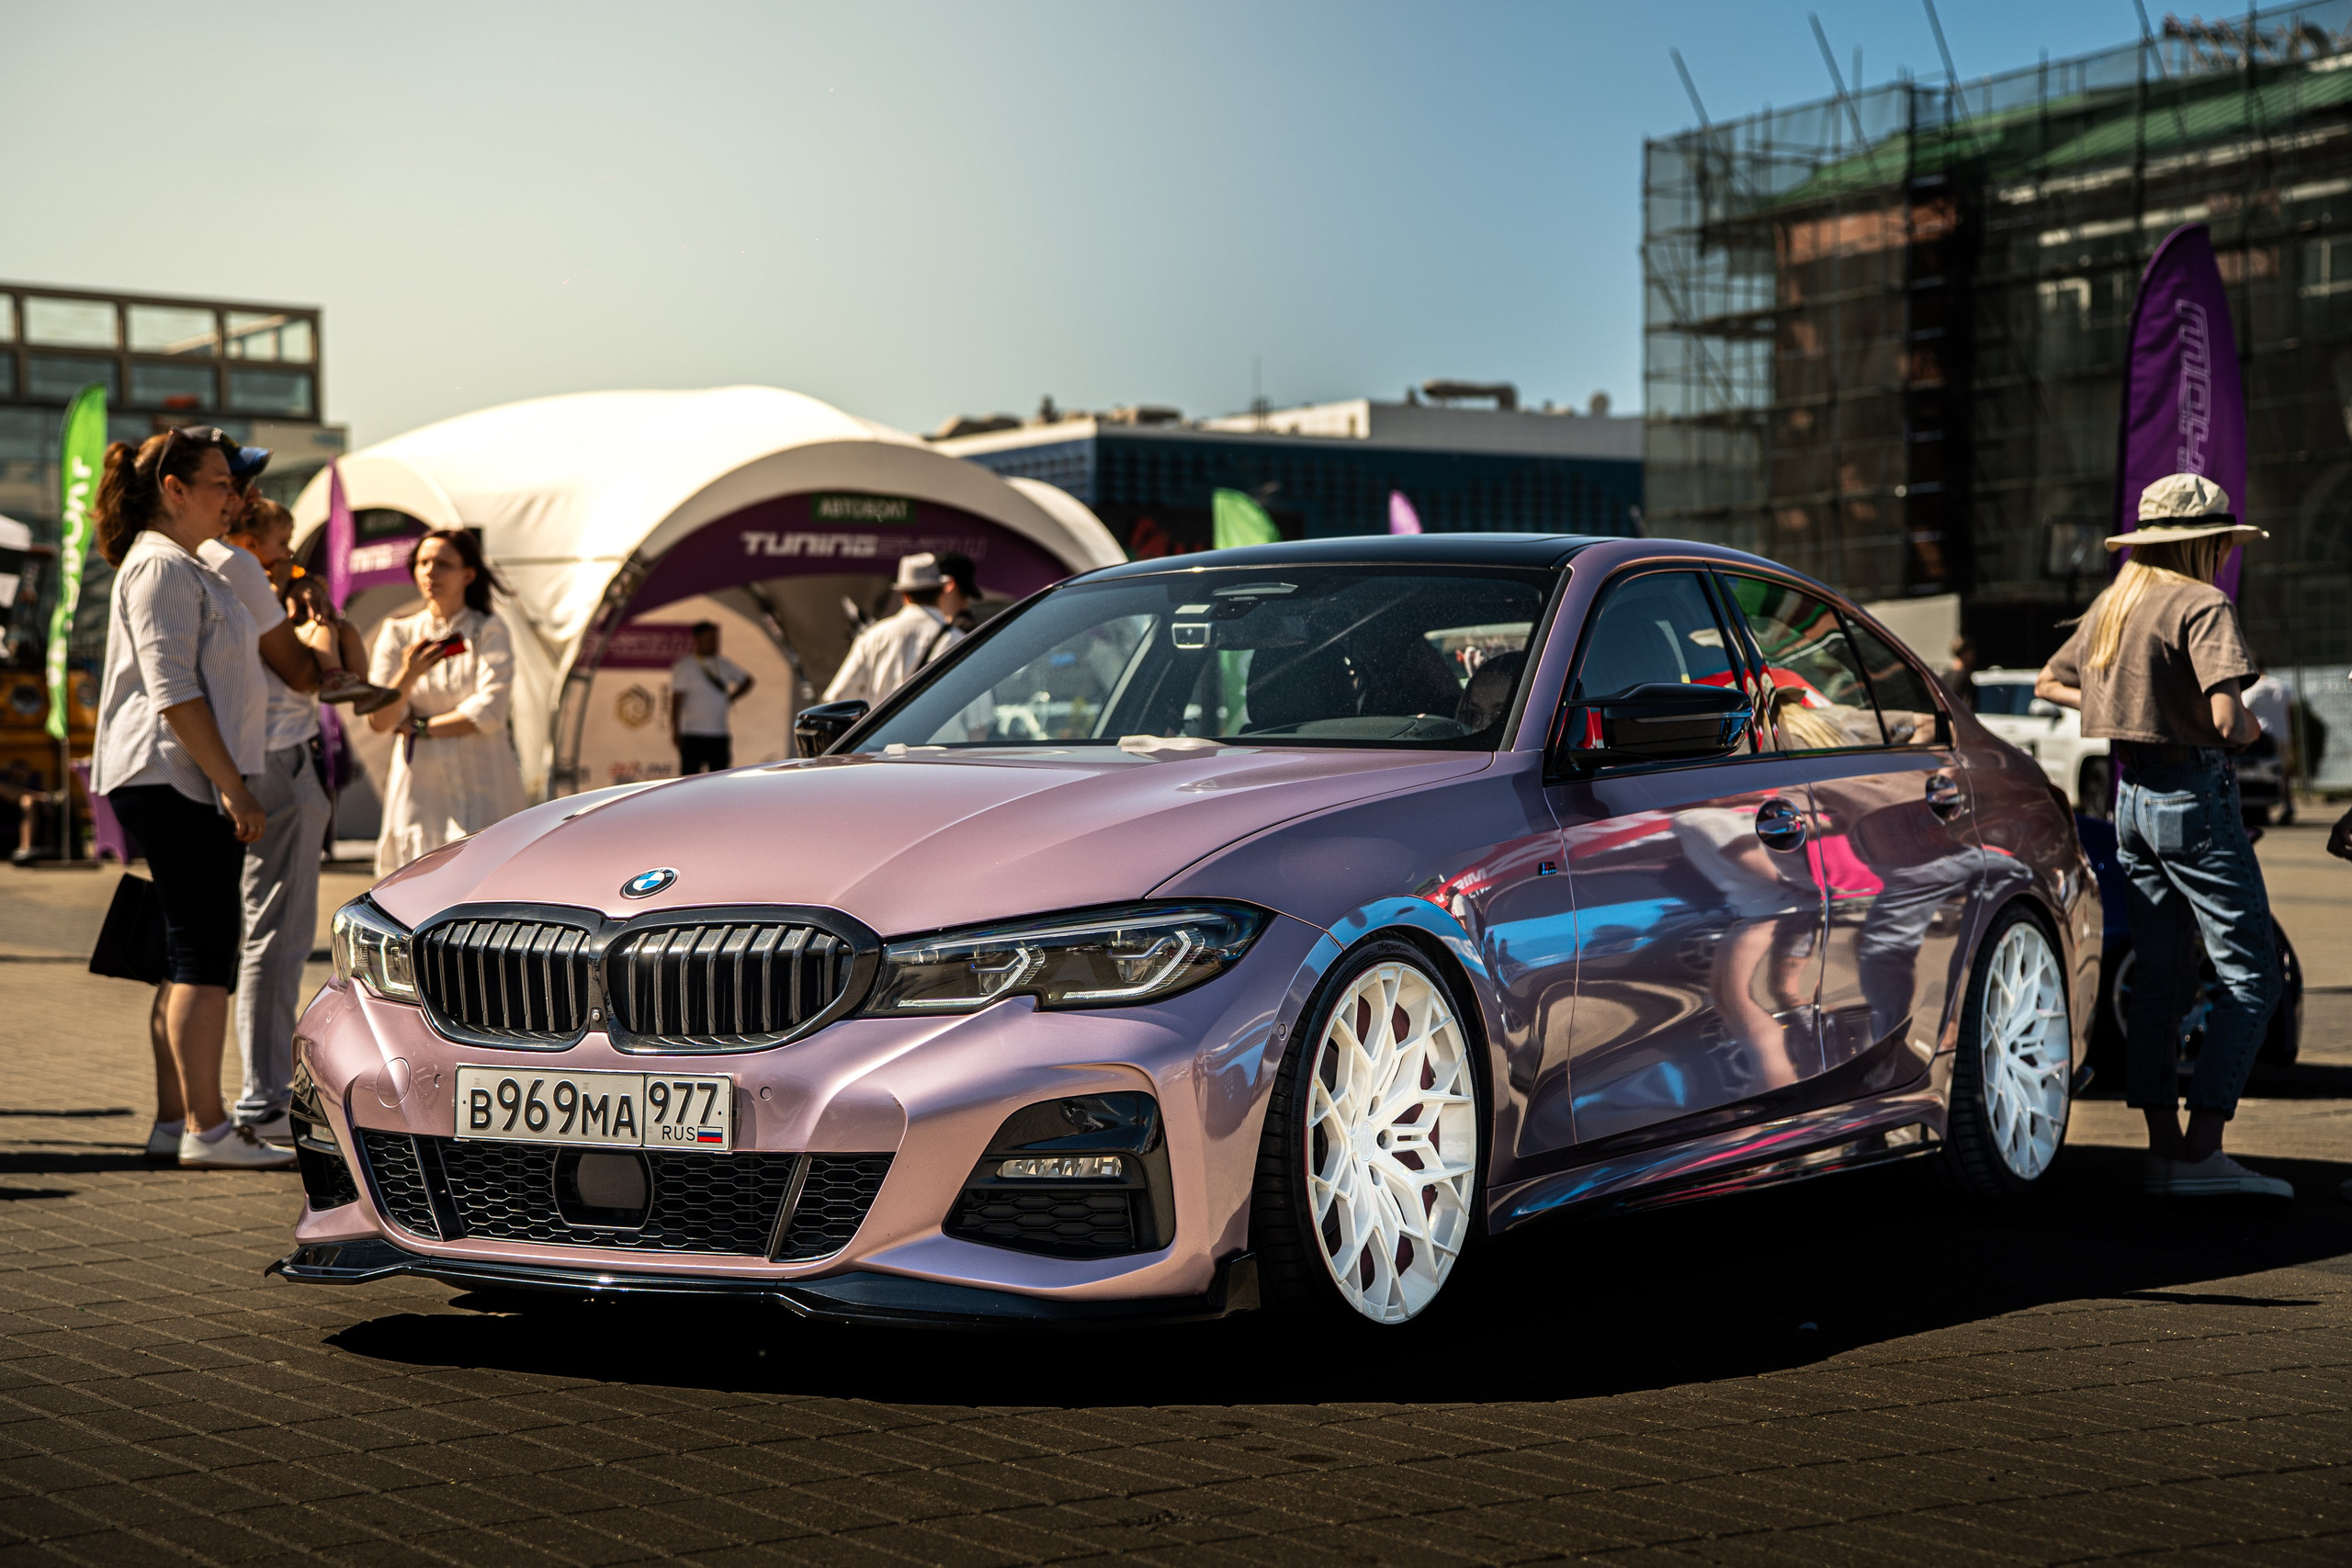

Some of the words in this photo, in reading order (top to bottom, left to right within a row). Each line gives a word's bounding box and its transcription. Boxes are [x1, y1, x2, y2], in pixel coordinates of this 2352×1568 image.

[2174, 299, 2211, 474] HOW
[649, 1081, 718, 1124] 977
[662, 1125, 695, 1142] RUS
